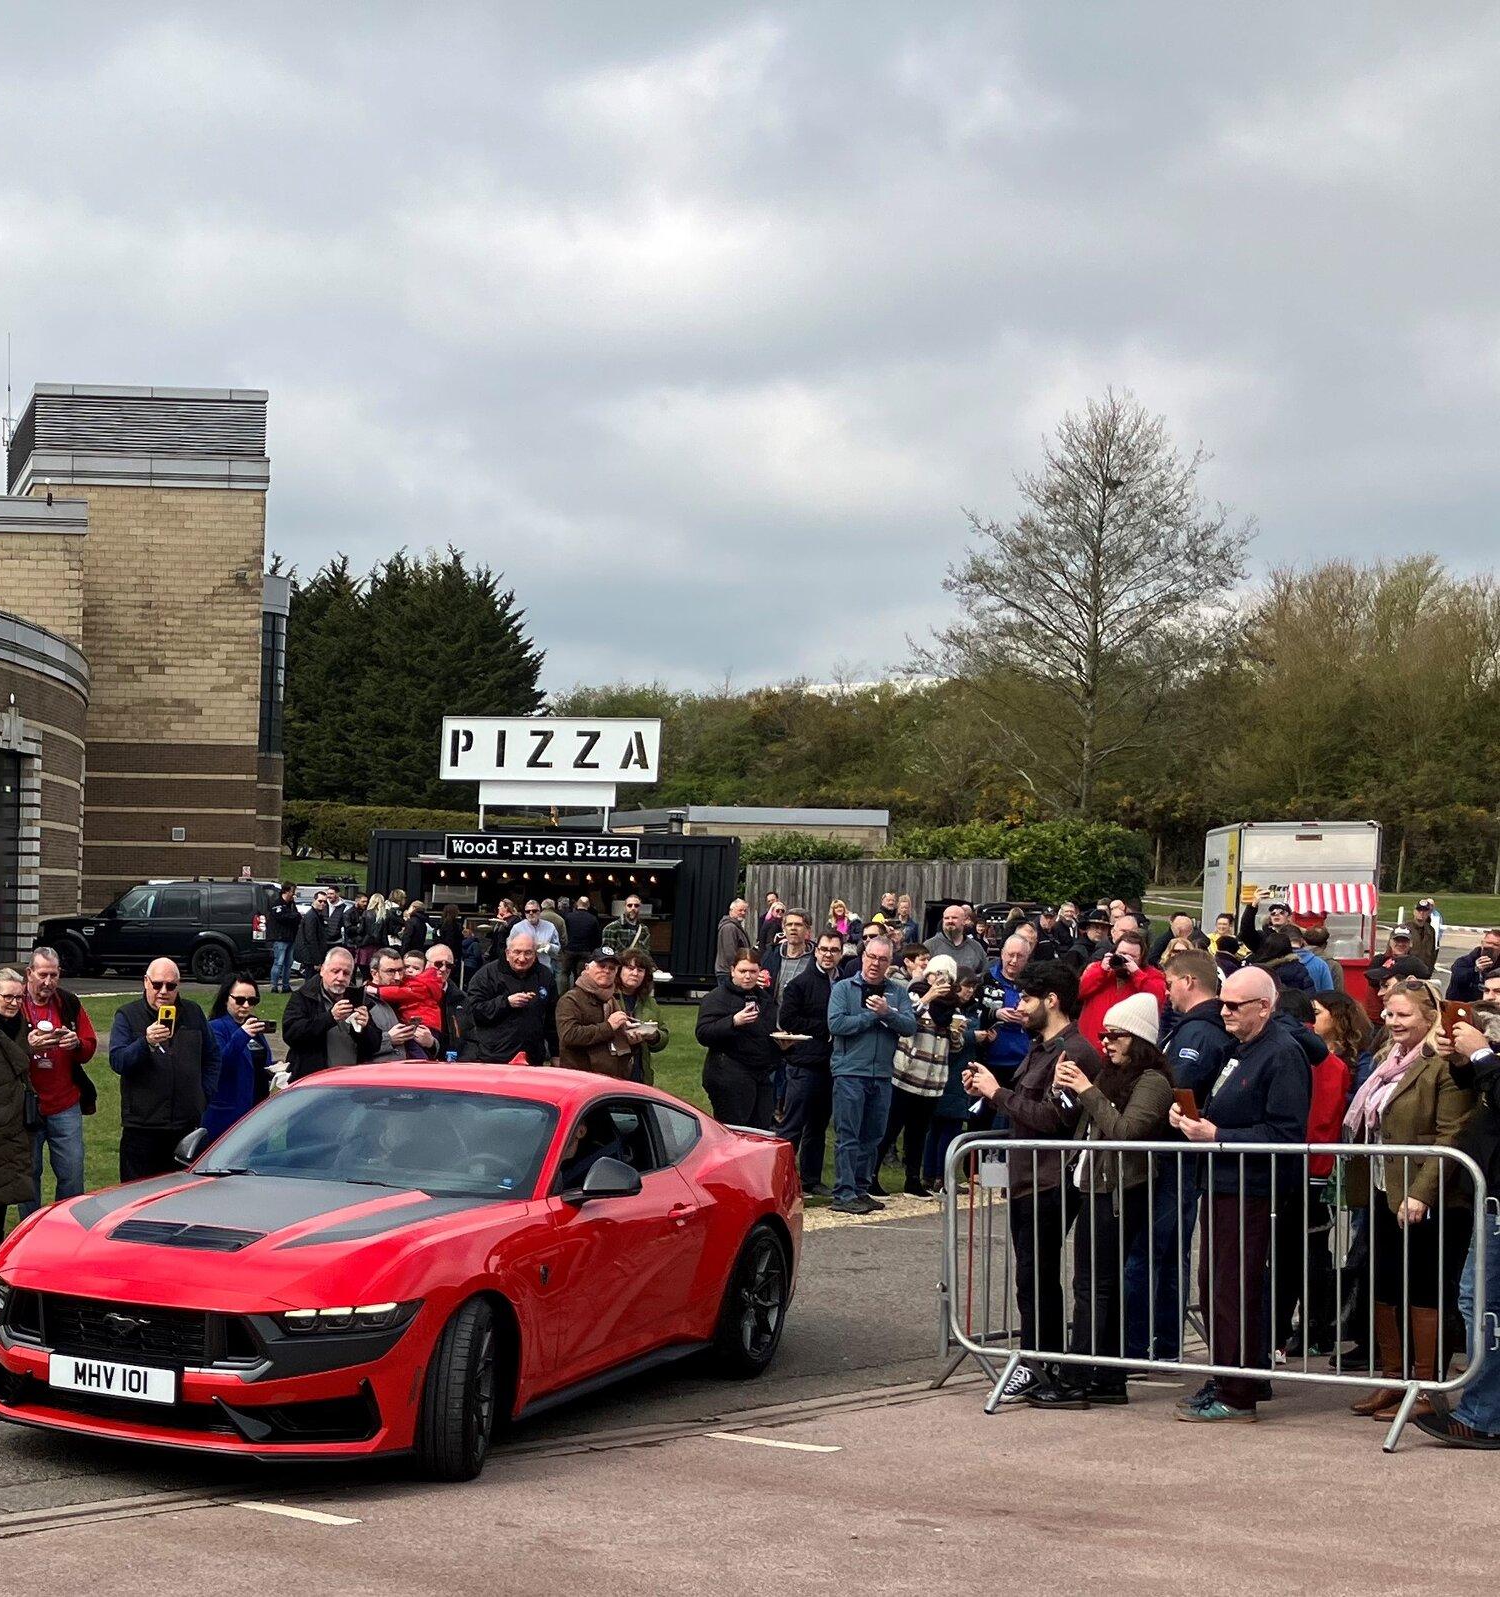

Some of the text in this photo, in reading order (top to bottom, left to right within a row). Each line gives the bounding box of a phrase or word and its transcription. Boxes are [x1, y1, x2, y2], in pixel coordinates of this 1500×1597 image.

[449, 729, 650, 770] PIZZA
[574, 841, 632, 858] Pizza
[73, 1361, 148, 1395] MHV 101
